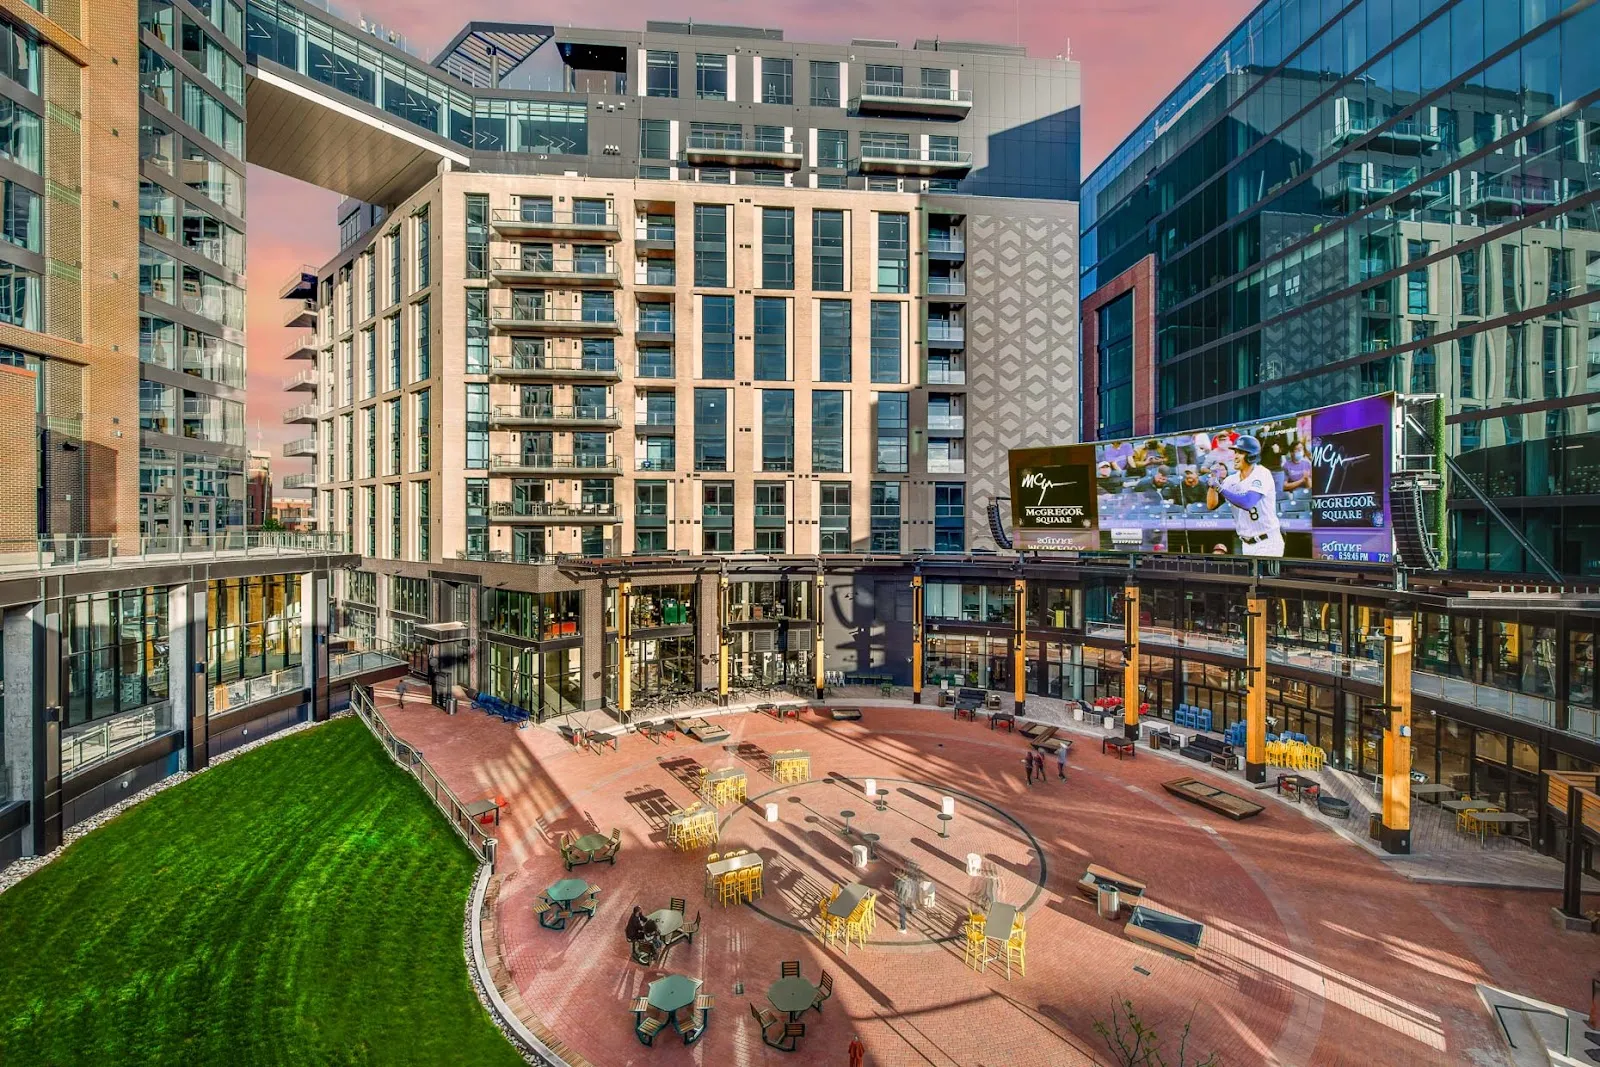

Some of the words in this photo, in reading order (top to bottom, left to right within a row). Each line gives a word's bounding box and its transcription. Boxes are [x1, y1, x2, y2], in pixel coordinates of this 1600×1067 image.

[1249, 507, 1259, 521] 8
[1322, 510, 1362, 522] SQUARE
[1036, 517, 1072, 525] SQUARE
[1360, 552, 1369, 562] PM
